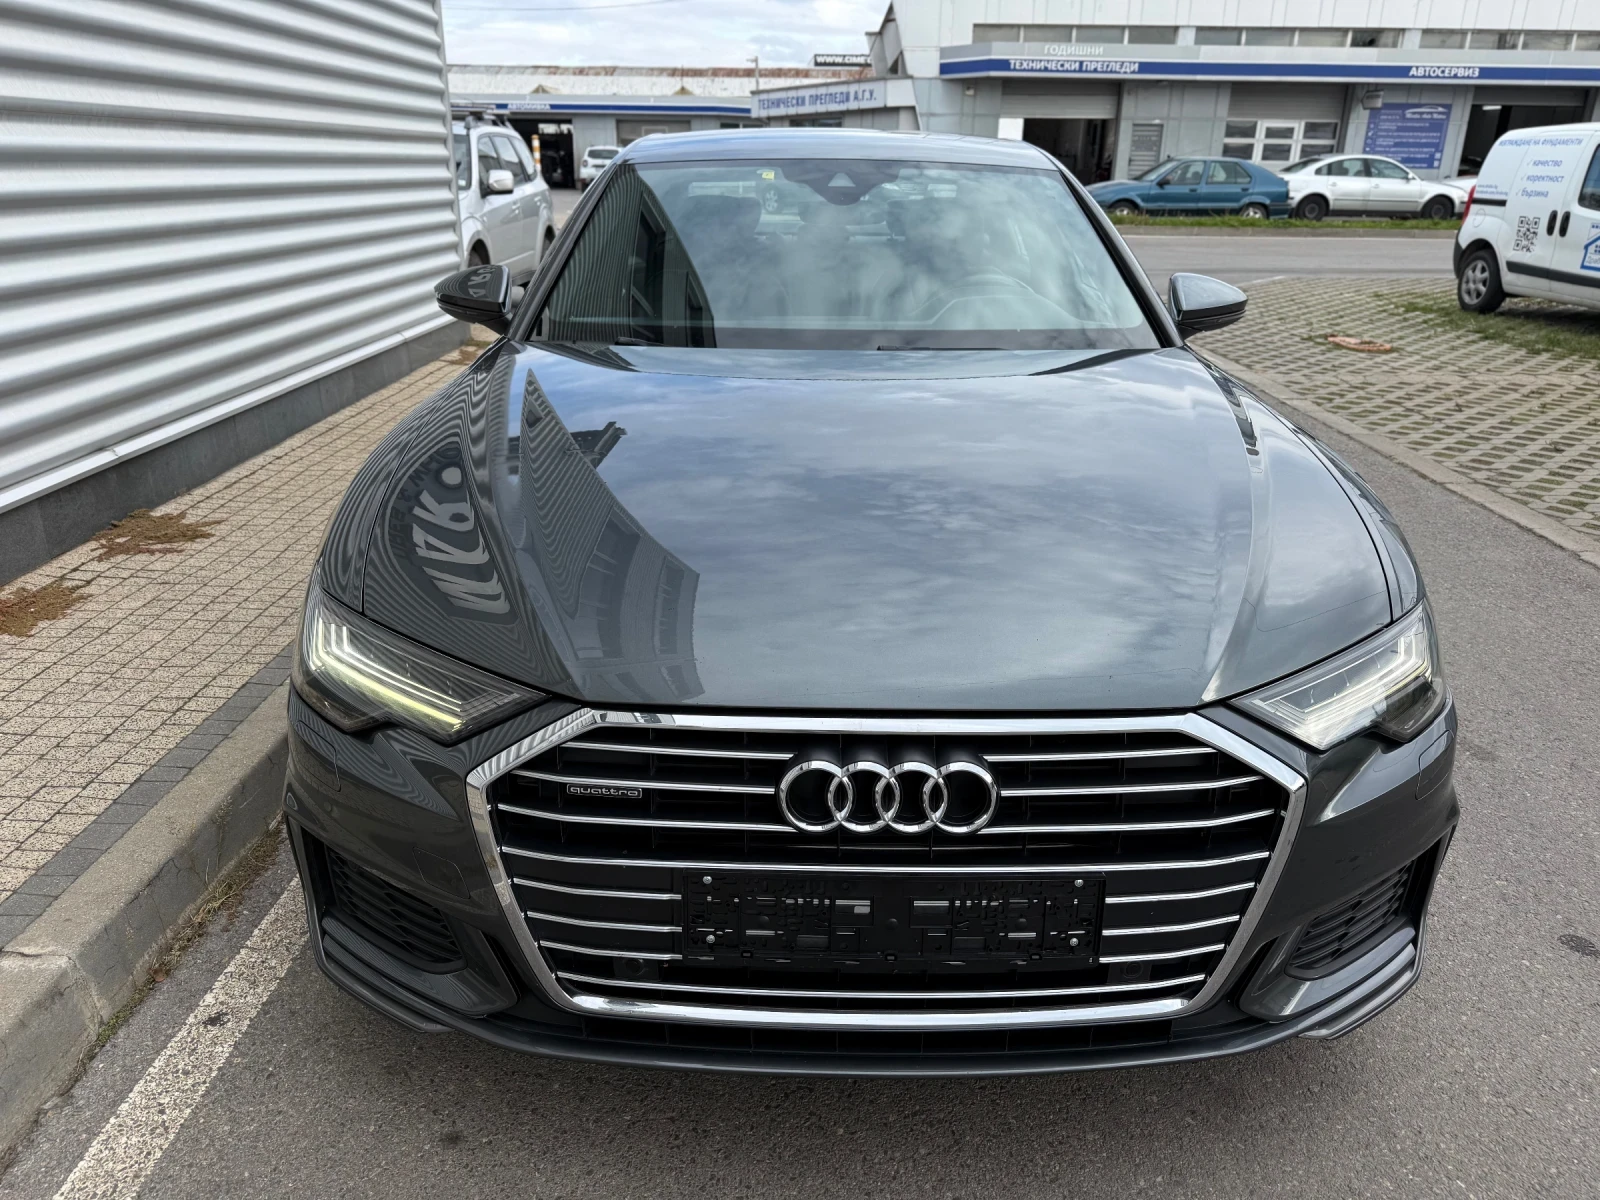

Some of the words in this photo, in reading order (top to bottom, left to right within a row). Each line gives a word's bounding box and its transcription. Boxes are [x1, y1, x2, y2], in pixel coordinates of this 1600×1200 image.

[1044, 45, 1104, 56] ГОДИШНИ
[1009, 60, 1080, 71] ТЕХНИЧЕСКИ
[1082, 62, 1139, 74] ПРЕГЛЕДИ
[1409, 67, 1480, 78] АВТОСЕРВИЗ
[758, 95, 806, 111] ТЕХНИЧЕСКИ
[808, 91, 851, 106] ПРЕГЛЕДИ
[853, 89, 877, 102] А.Г.У.
[1532, 159, 1563, 168] качество
[1526, 175, 1564, 184] коректност
[1521, 187, 1549, 199] бързина
[570, 786, 639, 797] quattro
